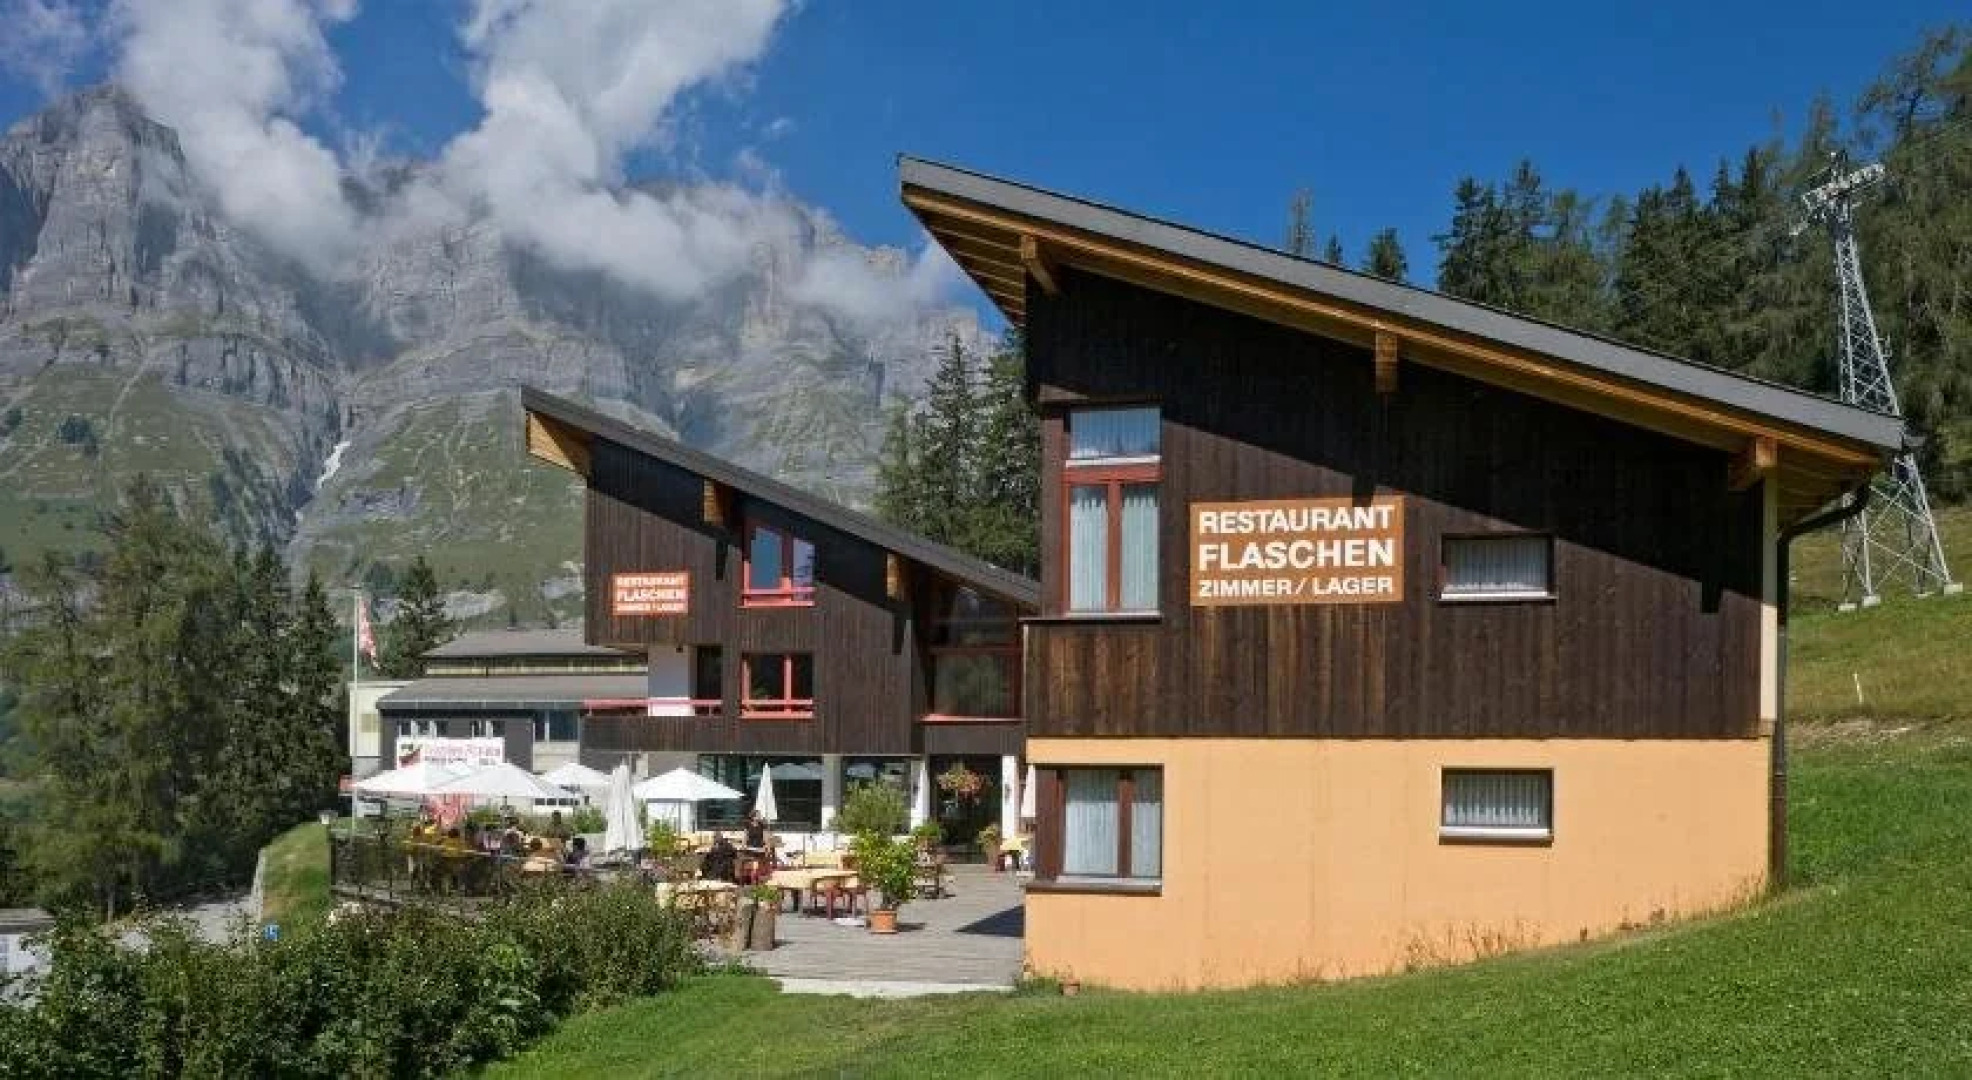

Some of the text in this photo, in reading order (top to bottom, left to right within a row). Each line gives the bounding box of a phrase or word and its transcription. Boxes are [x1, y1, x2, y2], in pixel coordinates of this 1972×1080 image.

[1199, 505, 1395, 534] RESTAURANT
[1199, 538, 1394, 571] FLASCHEN
[1313, 577, 1393, 595] LAGER
